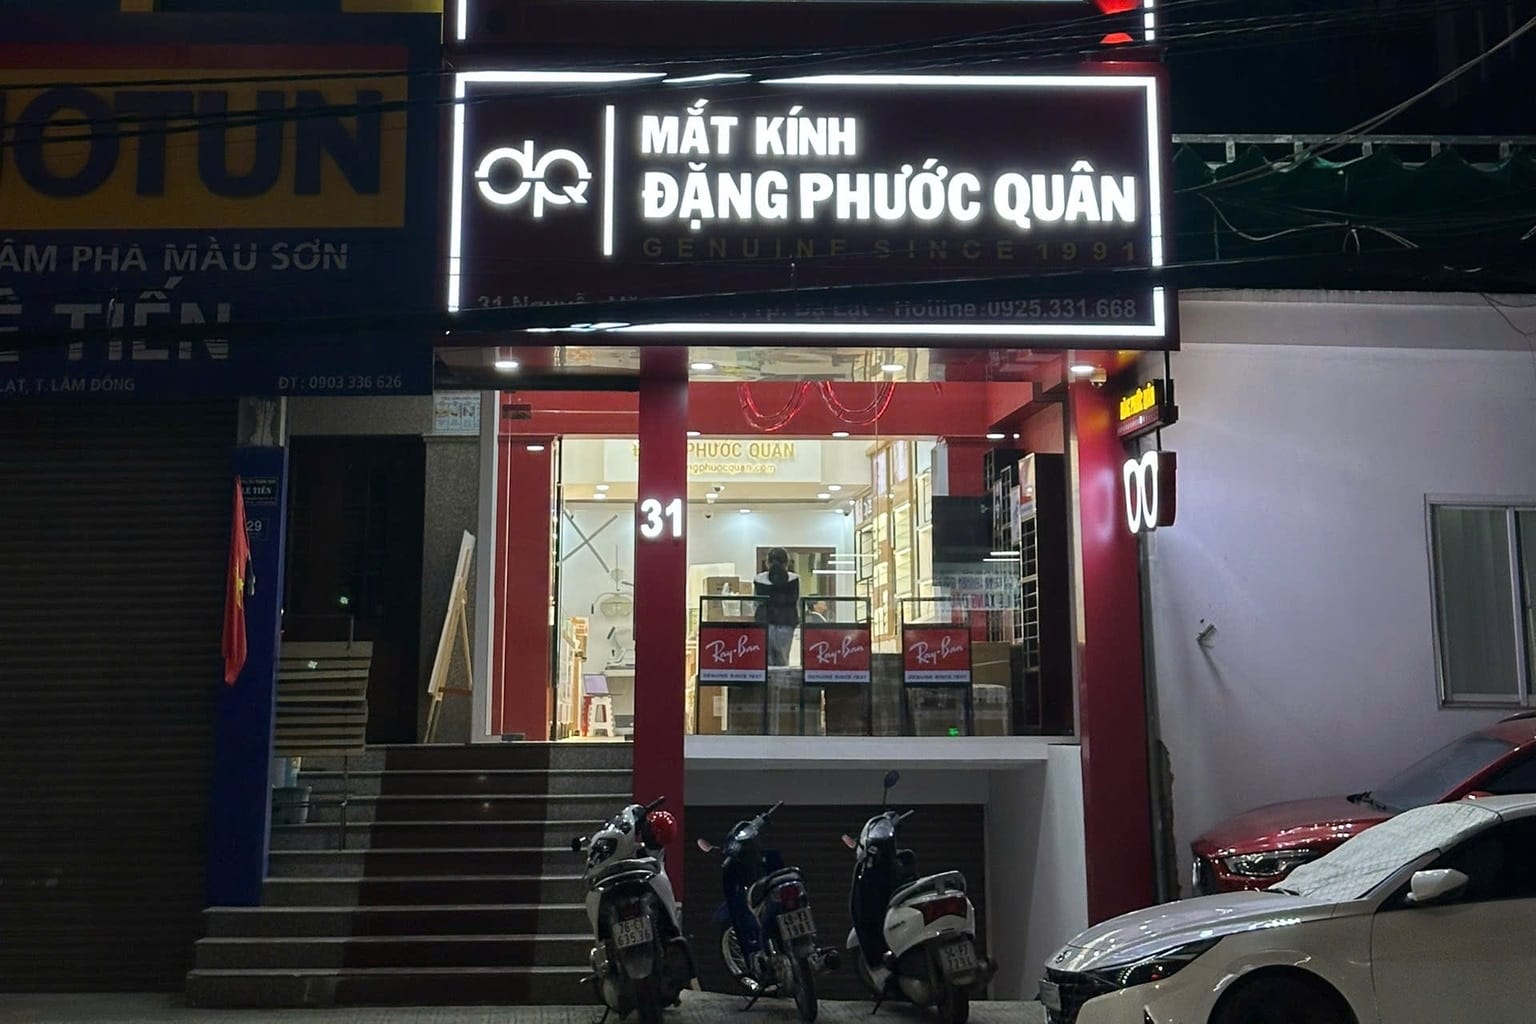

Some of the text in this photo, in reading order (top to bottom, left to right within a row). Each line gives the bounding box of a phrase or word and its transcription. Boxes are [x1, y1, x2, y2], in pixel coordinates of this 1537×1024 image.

[0, 84, 383, 199] OTUN
[641, 98, 857, 157] MẮT KÍNH
[642, 157, 1136, 230] ĐẶNG PHƯỚC QUÂN
[0, 237, 58, 273] ÂM
[164, 235, 257, 273] MÀU
[271, 238, 348, 272] SƠN
[642, 237, 1136, 263] GENUINE SINCE 1991
[54, 276, 232, 362] TIẾN
[309, 376, 344, 389] 0903
[348, 376, 373, 389] 336
[376, 375, 402, 389] 626
[246, 519, 263, 532] 29
[640, 498, 682, 538] 31
